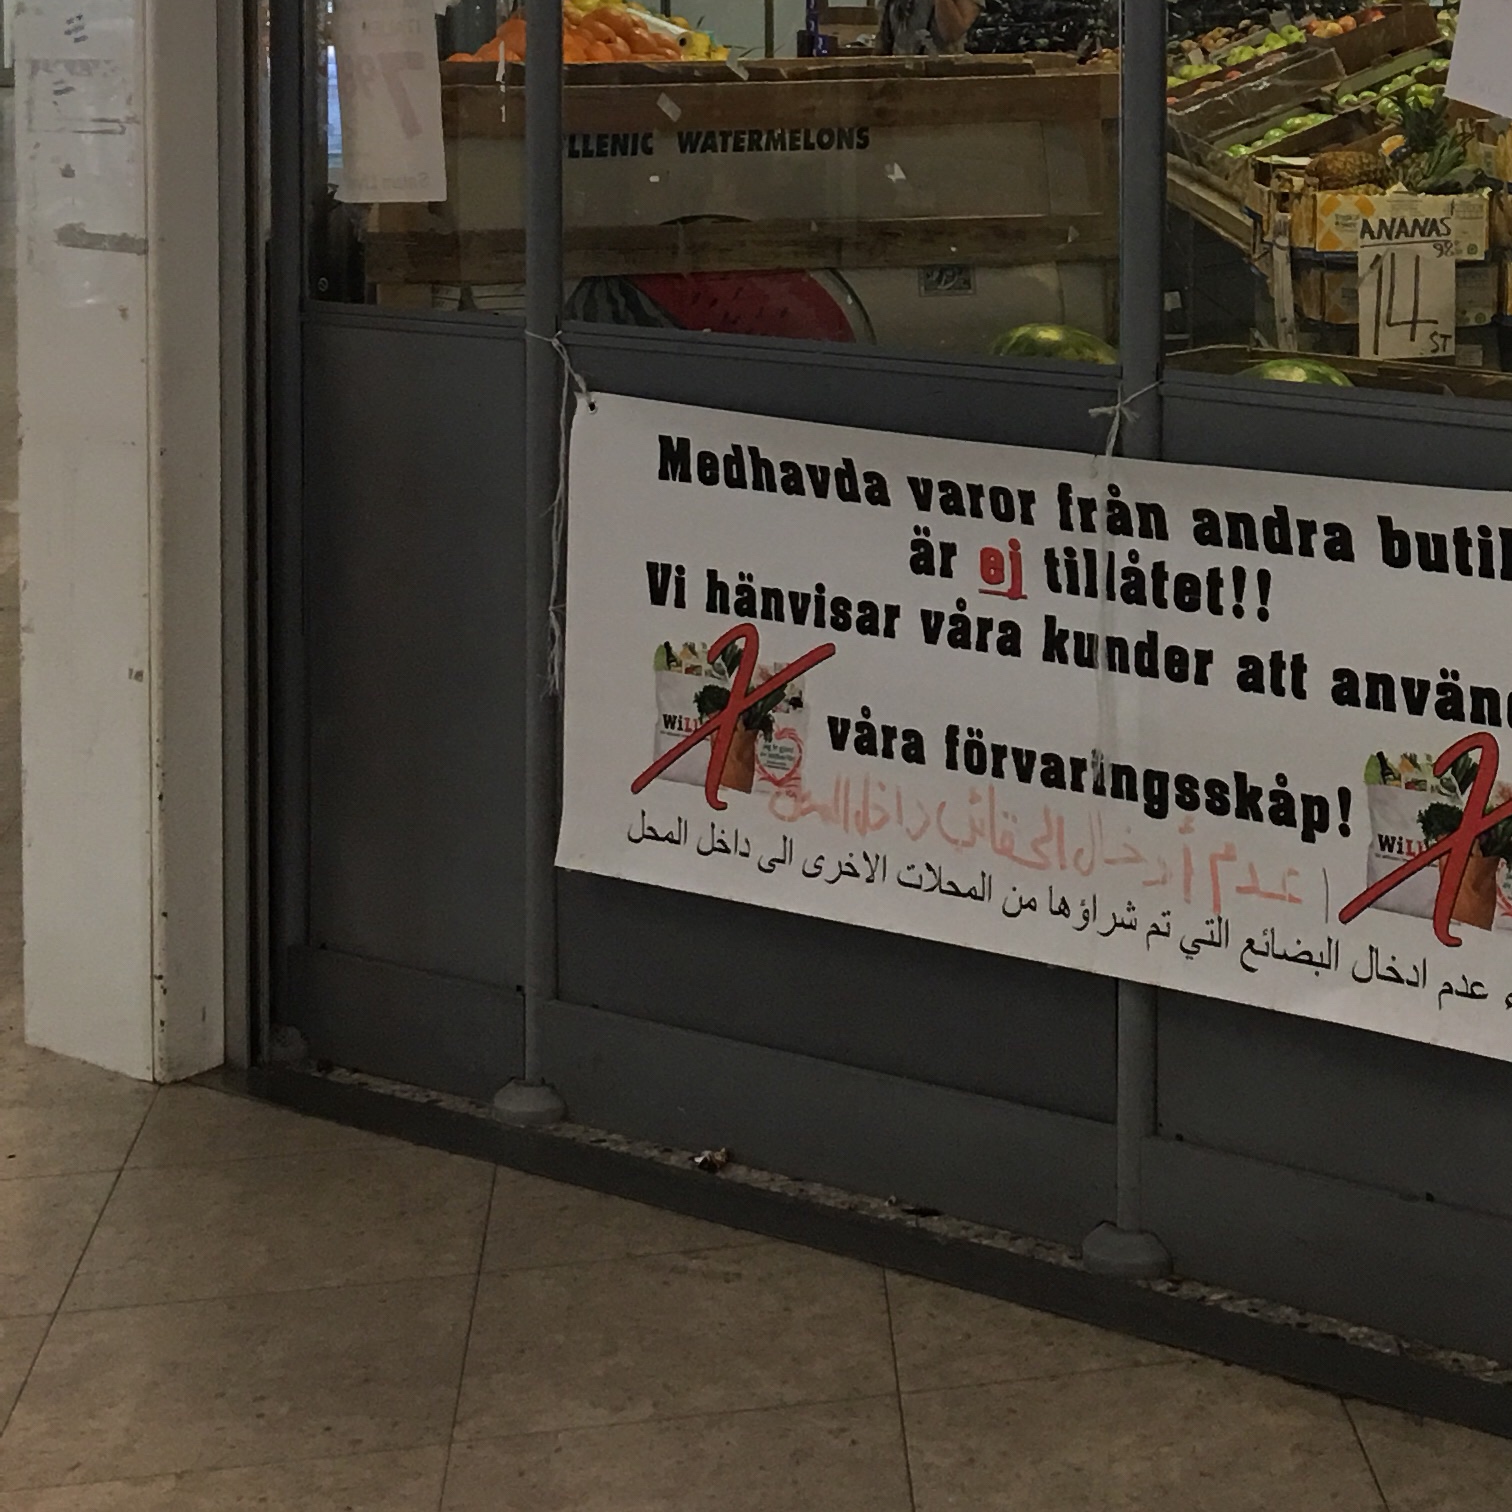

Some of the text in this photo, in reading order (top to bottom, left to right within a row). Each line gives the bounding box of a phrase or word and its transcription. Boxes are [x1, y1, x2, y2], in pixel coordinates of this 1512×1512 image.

[677, 126, 871, 155] WATERMELONS
[1360, 217, 1452, 241] ANANAS
[1429, 330, 1453, 354] ST
[656, 433, 892, 507] Medhavda
[906, 474, 1037, 527] varor
[1056, 481, 1170, 542] från
[1191, 503, 1357, 564] andra
[908, 524, 1273, 623] är ej tillåtet!!
[645, 559, 688, 610] Vi
[705, 567, 903, 640] hänvisar
[918, 597, 1024, 659] våra
[1040, 613, 1215, 688] kunder
[1236, 649, 1309, 701] att
[826, 704, 1354, 845] våra förvaringsskåp!
[626, 808, 689, 847] المحل
[695, 820, 752, 860] داخل
[896, 860, 993, 904] المحلات
[1000, 886, 1039, 919] من
[1144, 909, 1173, 952] تم
[1178, 913, 1231, 962] التي
[1238, 927, 1341, 977] البضائع
[1350, 943, 1428, 990] ادخال
[1436, 973, 1490, 1012] عدم
